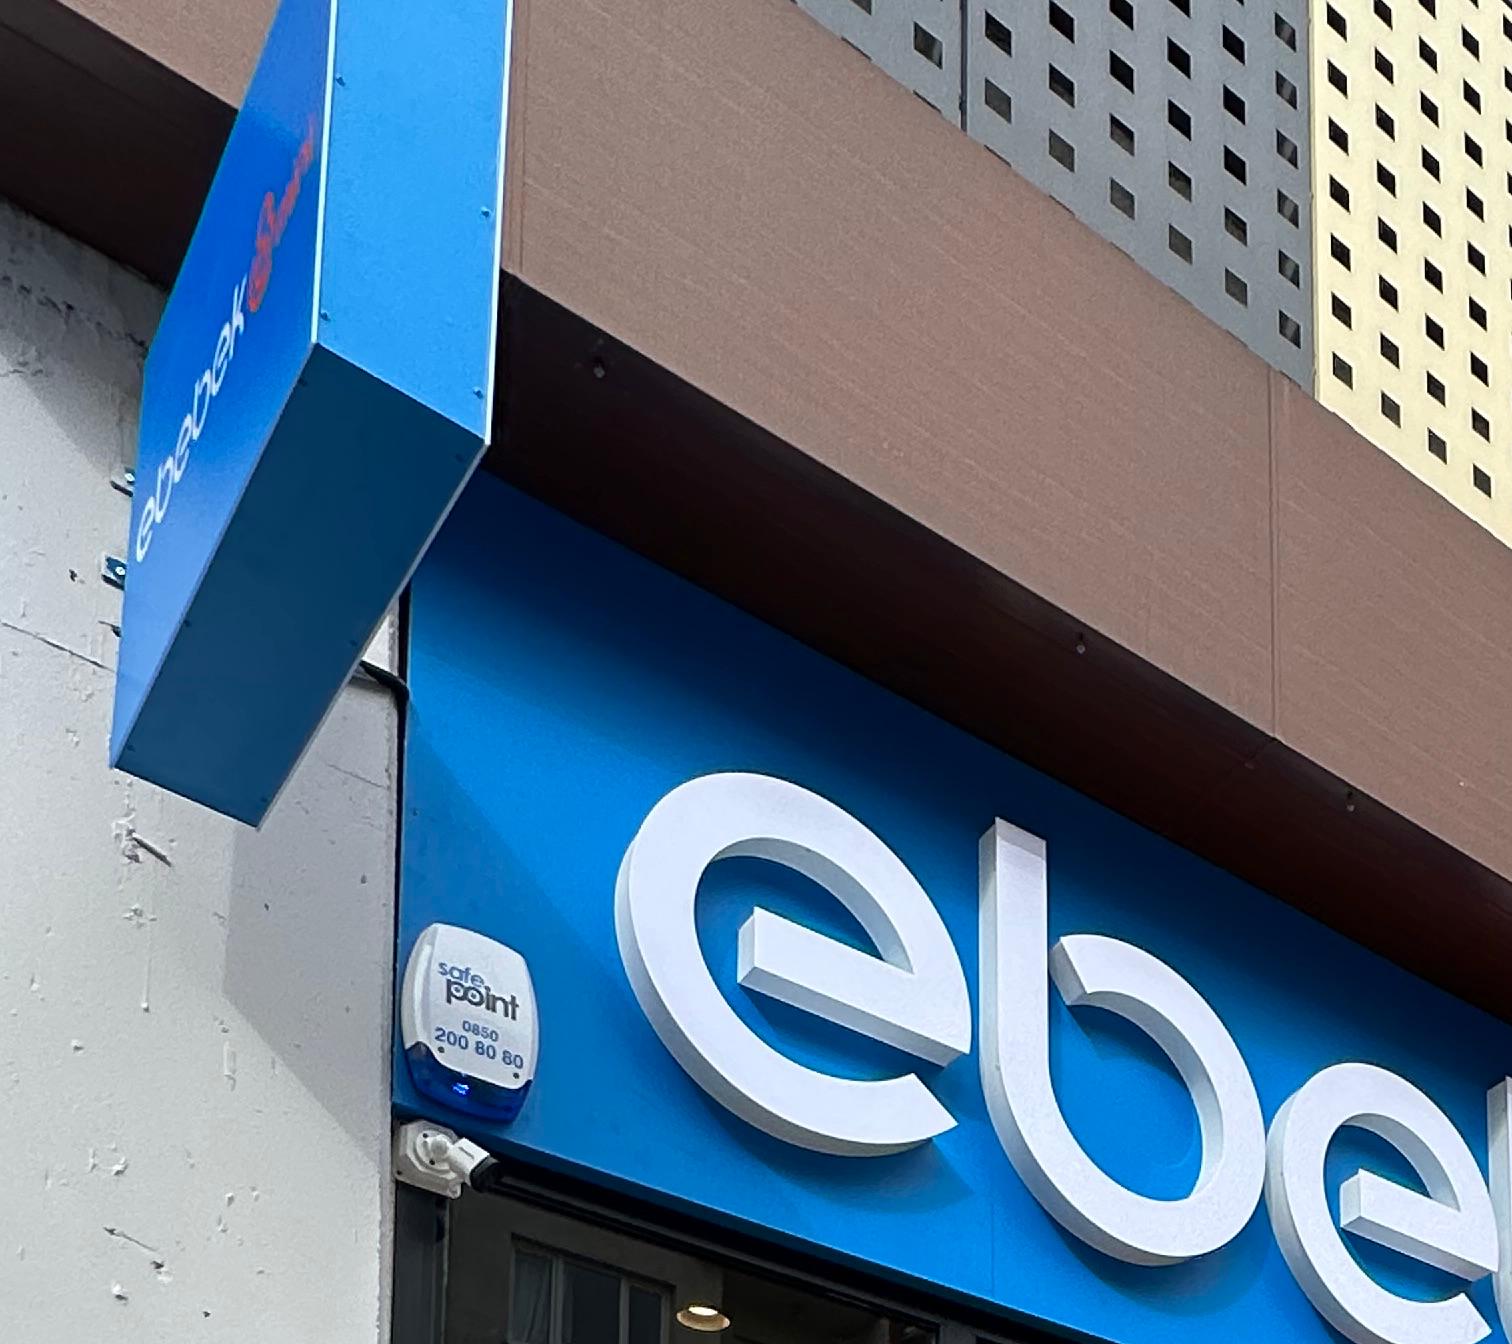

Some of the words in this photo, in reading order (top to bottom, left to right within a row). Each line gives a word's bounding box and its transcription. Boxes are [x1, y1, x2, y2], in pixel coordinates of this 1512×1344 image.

[438, 961, 485, 987] safe
[446, 978, 520, 1021] point
[434, 1026, 469, 1051] 200
[475, 1040, 497, 1060] 80
[502, 1050, 524, 1070] 80
[462, 1019, 499, 1043] 0850
